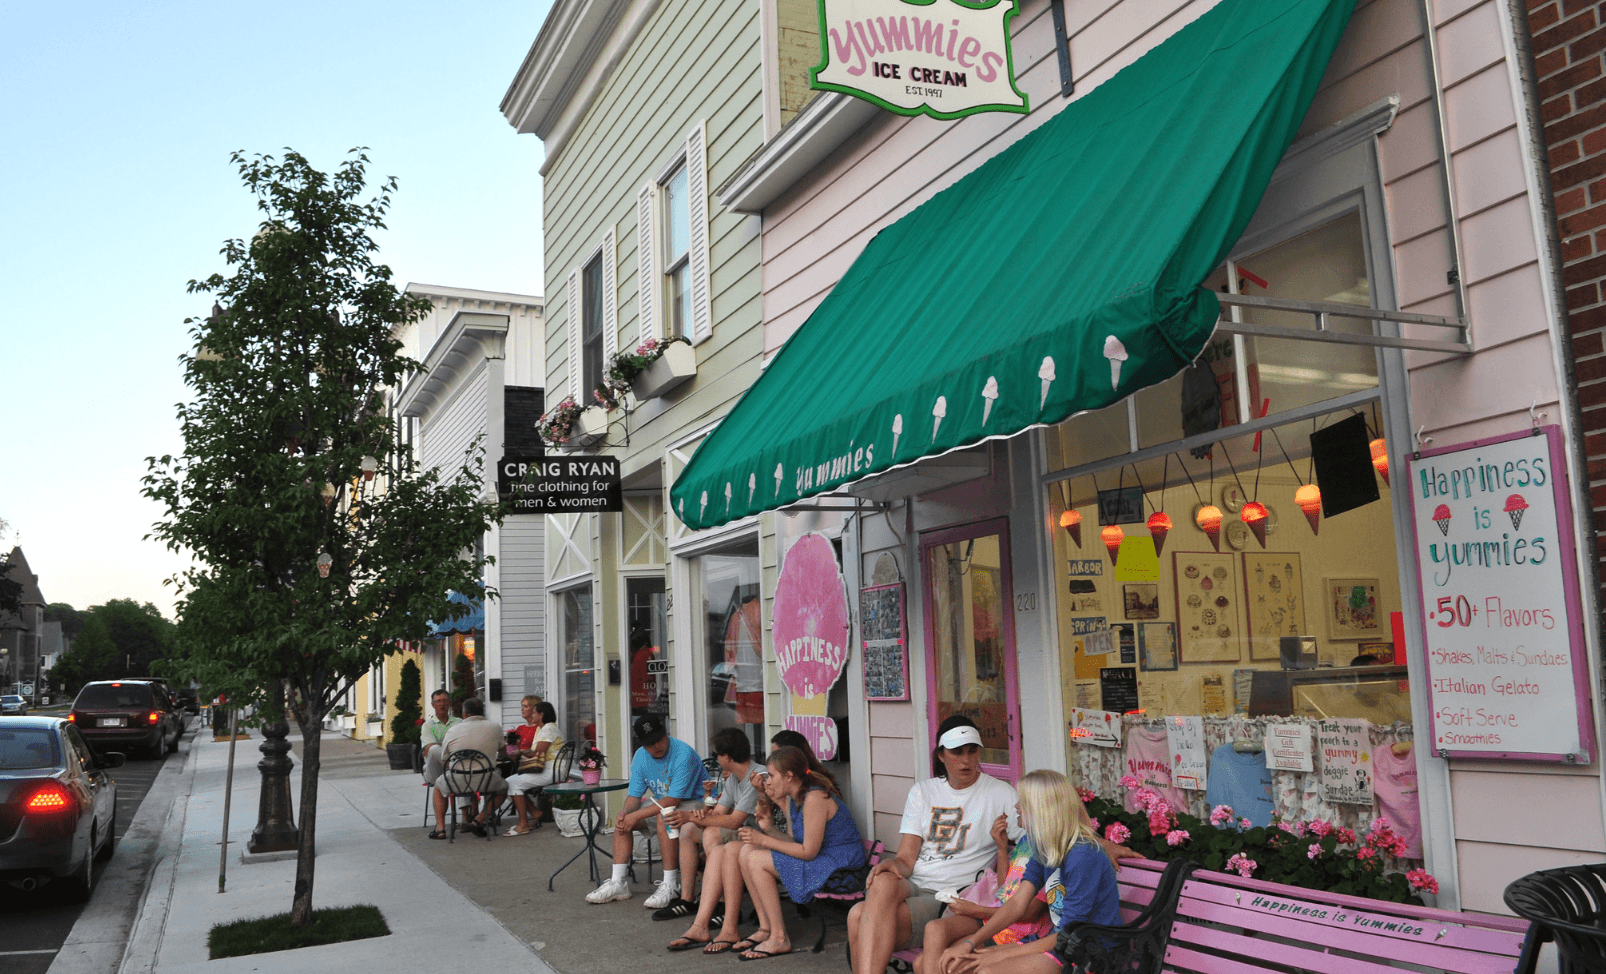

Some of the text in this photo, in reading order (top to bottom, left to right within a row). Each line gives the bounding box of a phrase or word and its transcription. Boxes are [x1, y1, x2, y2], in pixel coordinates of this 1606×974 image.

[873, 62, 967, 87] ICE CREAM
[569, 462, 615, 476] RYAN
[1420, 457, 1546, 500] Happiness
[538, 481, 589, 493] clothing
[593, 481, 610, 491] for
[547, 496, 556, 507] &
[560, 497, 607, 507] women
[1474, 506, 1492, 530] is
[1017, 592, 1036, 611] 220
[1437, 595, 1555, 630] 50+ Flavors
[1085, 632, 1114, 654] OPEN
[777, 636, 841, 677] HAPPINESS
[1477, 646, 1508, 664] Malts
[1516, 645, 1568, 667] Sundaes
[804, 677, 814, 700] is
[1435, 676, 1540, 696] Italian Gelato
[1441, 707, 1518, 727] Soft Serve
[1319, 721, 1363, 735] Treat your
[1281, 738, 1294, 746] Gift
[1320, 736, 1340, 748] pooch
[1342, 737, 1350, 746] to
[1445, 732, 1502, 745] Smoothies
[1325, 749, 1358, 765] yummy
[1324, 765, 1349, 780] doggie
[1325, 783, 1354, 797] Sundae
[1252, 897, 1424, 936] Happiness is Yummies
